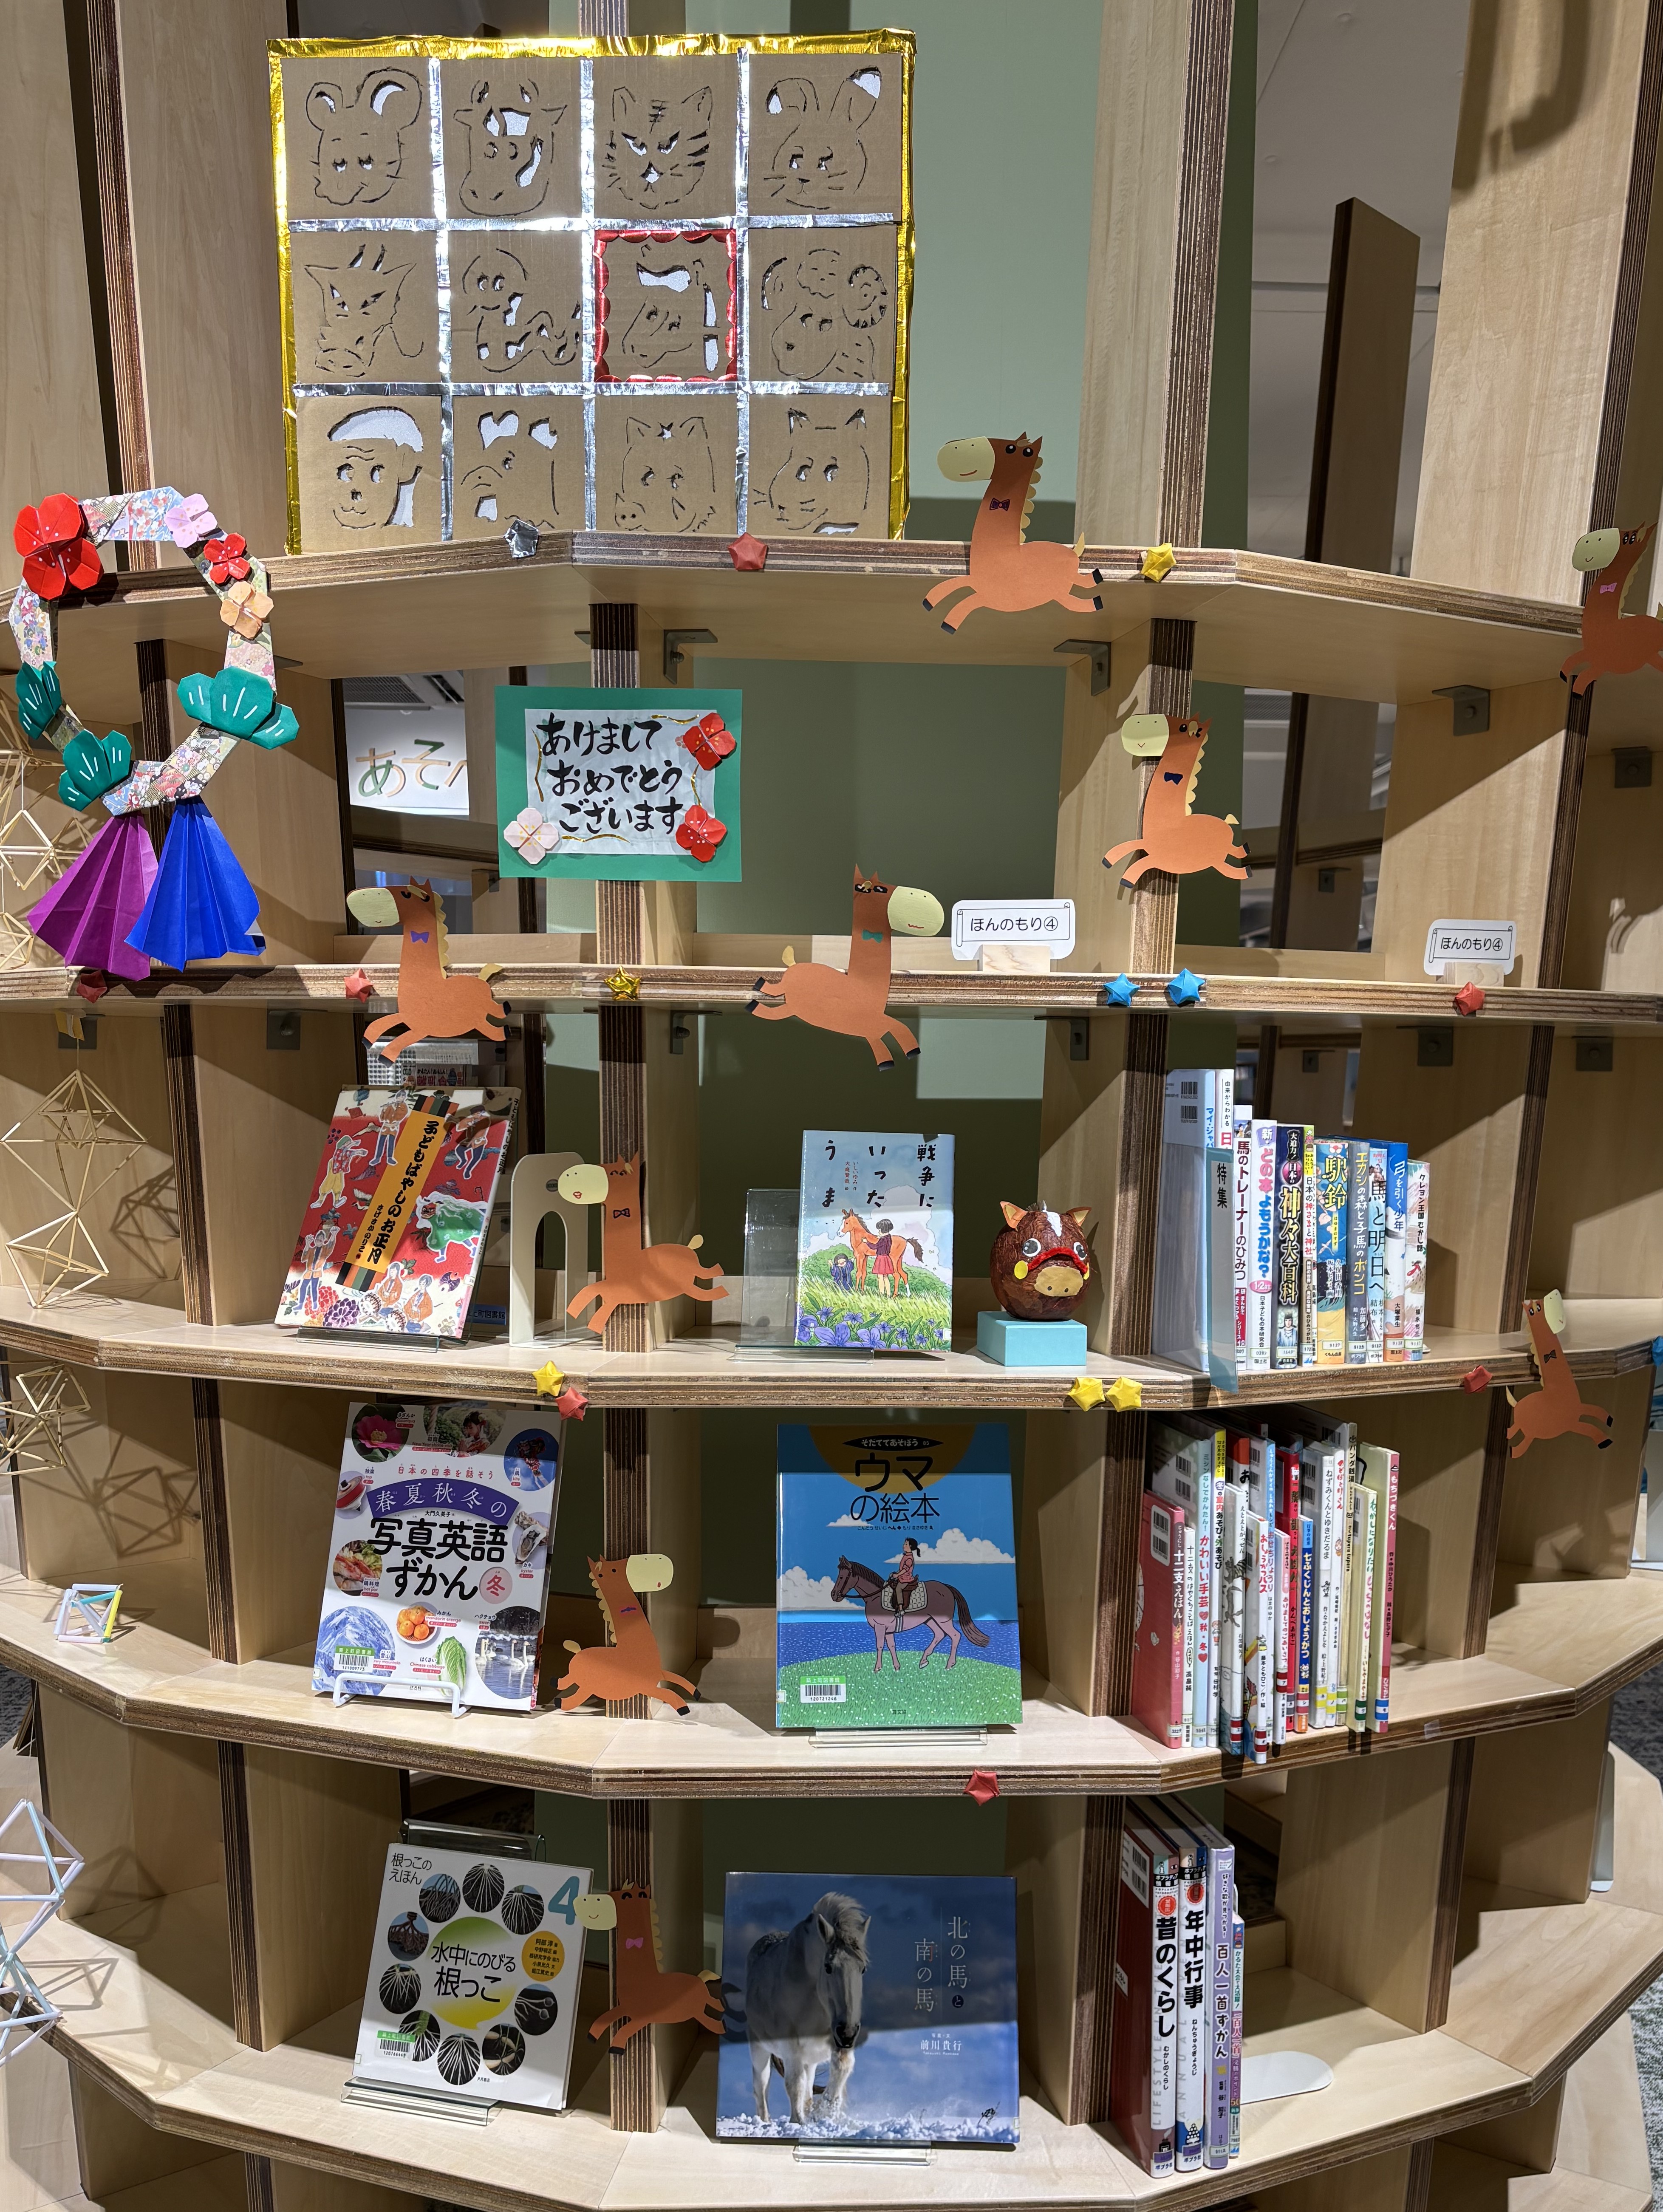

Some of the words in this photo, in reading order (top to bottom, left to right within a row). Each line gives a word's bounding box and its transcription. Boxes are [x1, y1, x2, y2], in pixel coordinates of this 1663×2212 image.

[535, 712, 663, 758] あけまして
[547, 759, 683, 798] おめでとう
[559, 796, 684, 834] ございます
[970, 913, 1060, 933] ほんのもり④
[1440, 936, 1504, 953] ほんのもり④
[1221, 1132, 1232, 1149] 日
[1290, 1132, 1298, 1160] 大迫力！
[822, 1140, 836, 1207] うま
[867, 1146, 886, 1208] いった
[917, 1144, 936, 1208] 戦争に
[1217, 1163, 1227, 1208] 特集
[1289, 1163, 1297, 1183] 日本の
[1322, 1157, 1347, 1209] 駅鈴
[1394, 1160, 1405, 1231] 弓を引く少年
[358, 1204, 385, 1253] さげさかのりこ
[1235, 1141, 1250, 1281] 馬のトレーナーのひみつ
[1256, 1147, 1274, 1278] どの本よもうかな？
[1305, 1177, 1313, 1255] 日本の神さまと神社
[1353, 1153, 1368, 1295] エカシの森と子馬のポンコ
[1280, 1186, 1301, 1303] 神々大百科
[1368, 1180, 1386, 1290] 馬と明日へ
[468, 1310, 506, 1319] 上町図書館
[861, 1439, 918, 1447] そだててあそぼう
[1349, 1445, 1357, 1482] パンダ銭湯
[398, 1466, 493, 1479] 日本の四季を話そう
[855, 1452, 933, 1492] ウマ
[376, 1482, 506, 1518] 春夏秋冬の
[850, 1492, 940, 1524] の絵本
[1324, 1470, 1333, 1559] ねずみくんとゆきだるま
[1389, 1475, 1398, 1530] もちづきくん
[367, 1518, 509, 1563] 写真英語
[1215, 1480, 1225, 1569] 冬の室内あそび・外あそび
[386, 1557, 478, 1601] ずかん
[486, 1575, 506, 1596] 冬
[1173, 1550, 1184, 1619] 十二支えほん
[1198, 1535, 1210, 1607] かわいい手芸
[1259, 1534, 1268, 1593] おしょうがつバス
[1301, 1552, 1312, 1658] 七ふくじんとおしょうがつ
[1199, 1623, 1208, 1651] 秋・冬
[388, 1869, 422, 1885] えほん
[391, 1853, 432, 1870] 根っこの
[548, 1875, 580, 1926] 4
[431, 1942, 516, 1973] 水中にのびる
[914, 1938, 935, 2012] 南の馬
[947, 1916, 968, 2008] 北の馬と
[1156, 1917, 1177, 2037] 昔のくらし
[1184, 1910, 1204, 2010] 年中行事
[434, 1966, 502, 2003] 根っこ
[1215, 1944, 1230, 2058] 百人一首ずかん
[921, 2040, 962, 2051] 前川貴行
[1177, 2019, 1187, 2119] ANNUAL
[1153, 2035, 1162, 2126] LIFESTYLE
[1155, 2162, 1173, 2170] ポプラ社
[1184, 2155, 1202, 2163] ポプラ社
